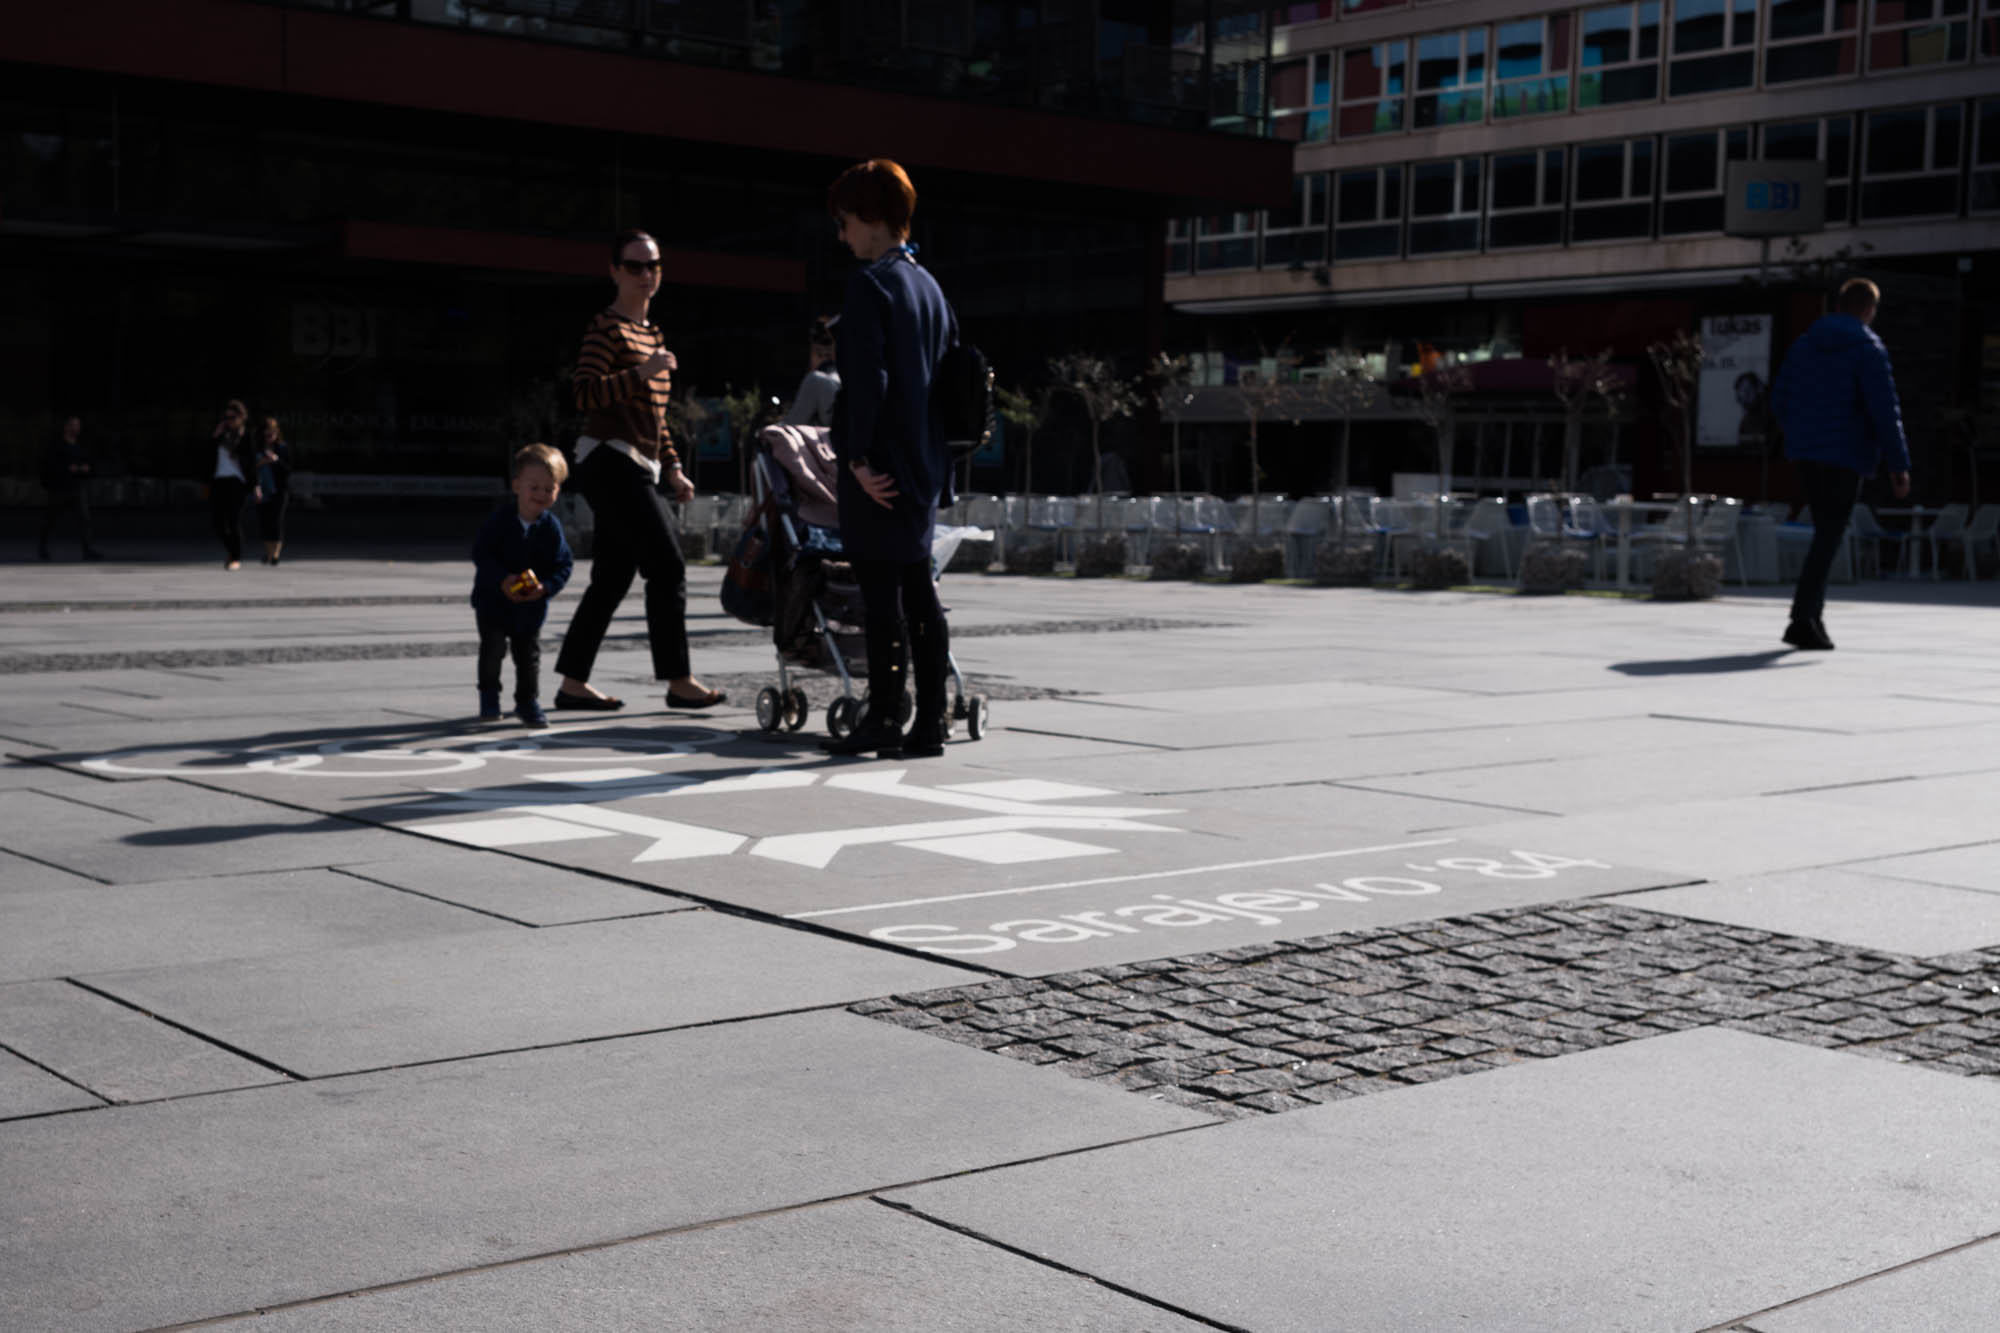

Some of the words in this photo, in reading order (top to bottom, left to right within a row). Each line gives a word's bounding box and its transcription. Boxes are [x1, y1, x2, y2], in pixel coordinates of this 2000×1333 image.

[1746, 182, 1800, 210] BBI
[292, 304, 377, 358] BBI
[869, 876, 1442, 953] Sarajevo
